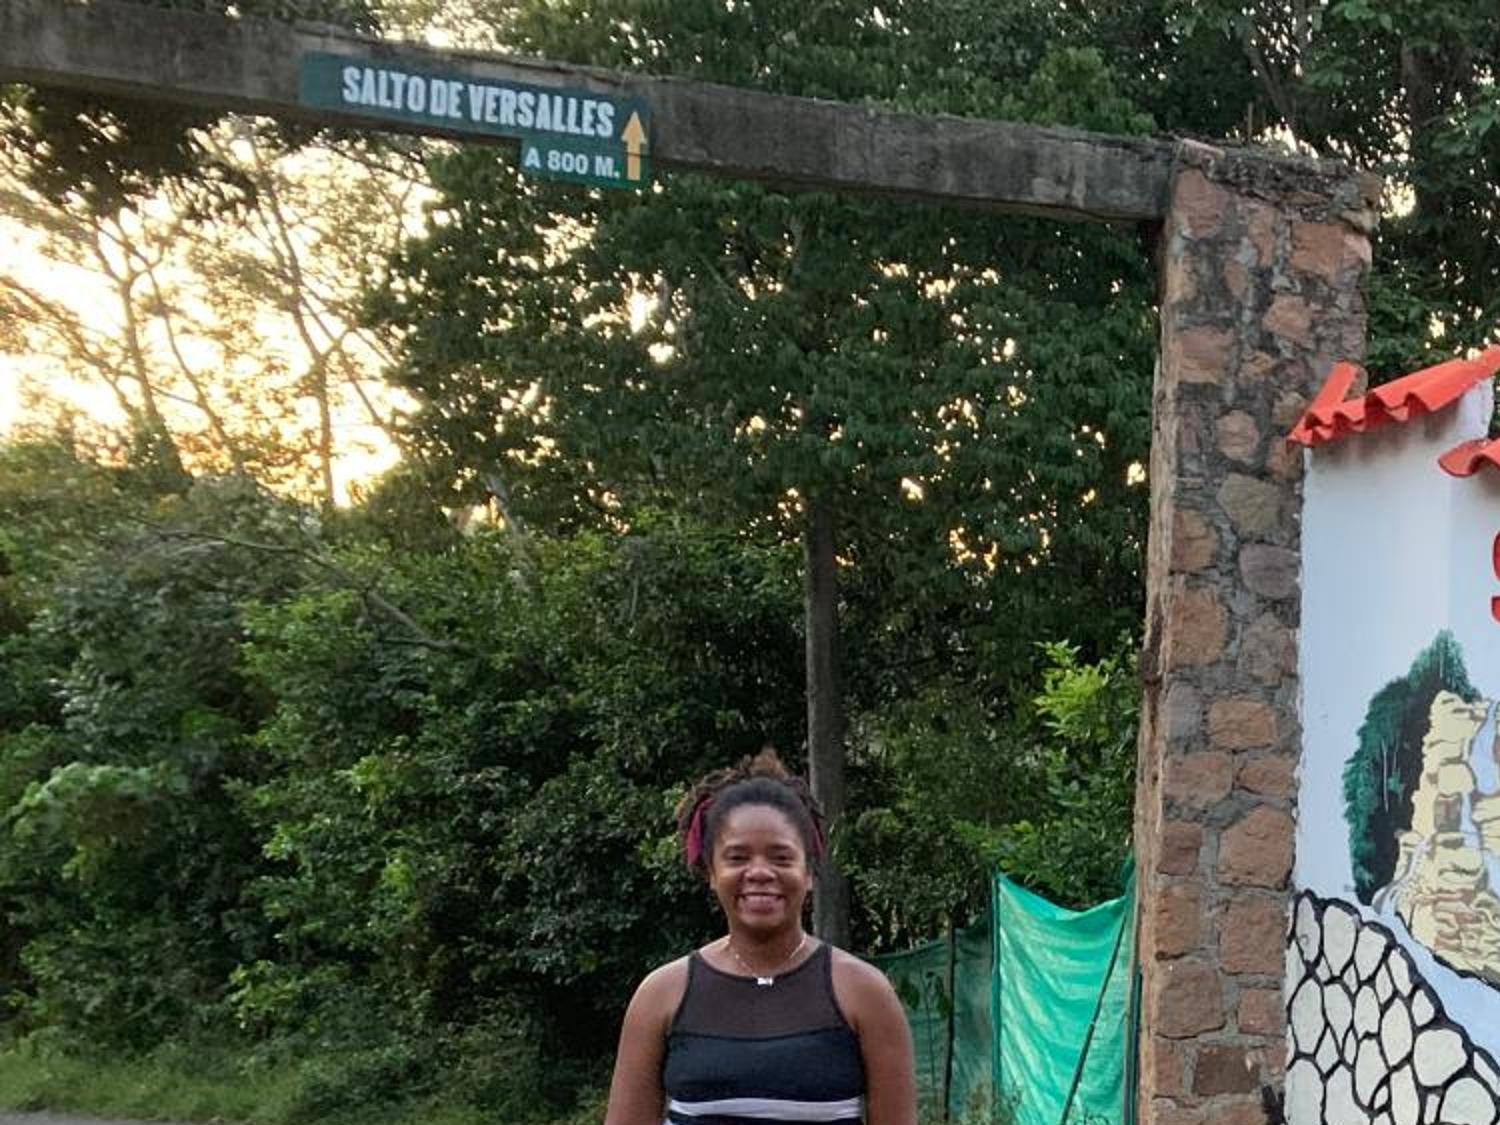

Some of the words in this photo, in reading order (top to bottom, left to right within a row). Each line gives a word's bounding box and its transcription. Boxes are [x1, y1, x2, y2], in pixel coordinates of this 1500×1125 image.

[342, 66, 424, 112] SALTO
[430, 78, 464, 119] DE
[468, 85, 615, 139] VERSALLES
[525, 149, 541, 168] A
[547, 154, 590, 176] 800
[594, 157, 620, 179] M.
